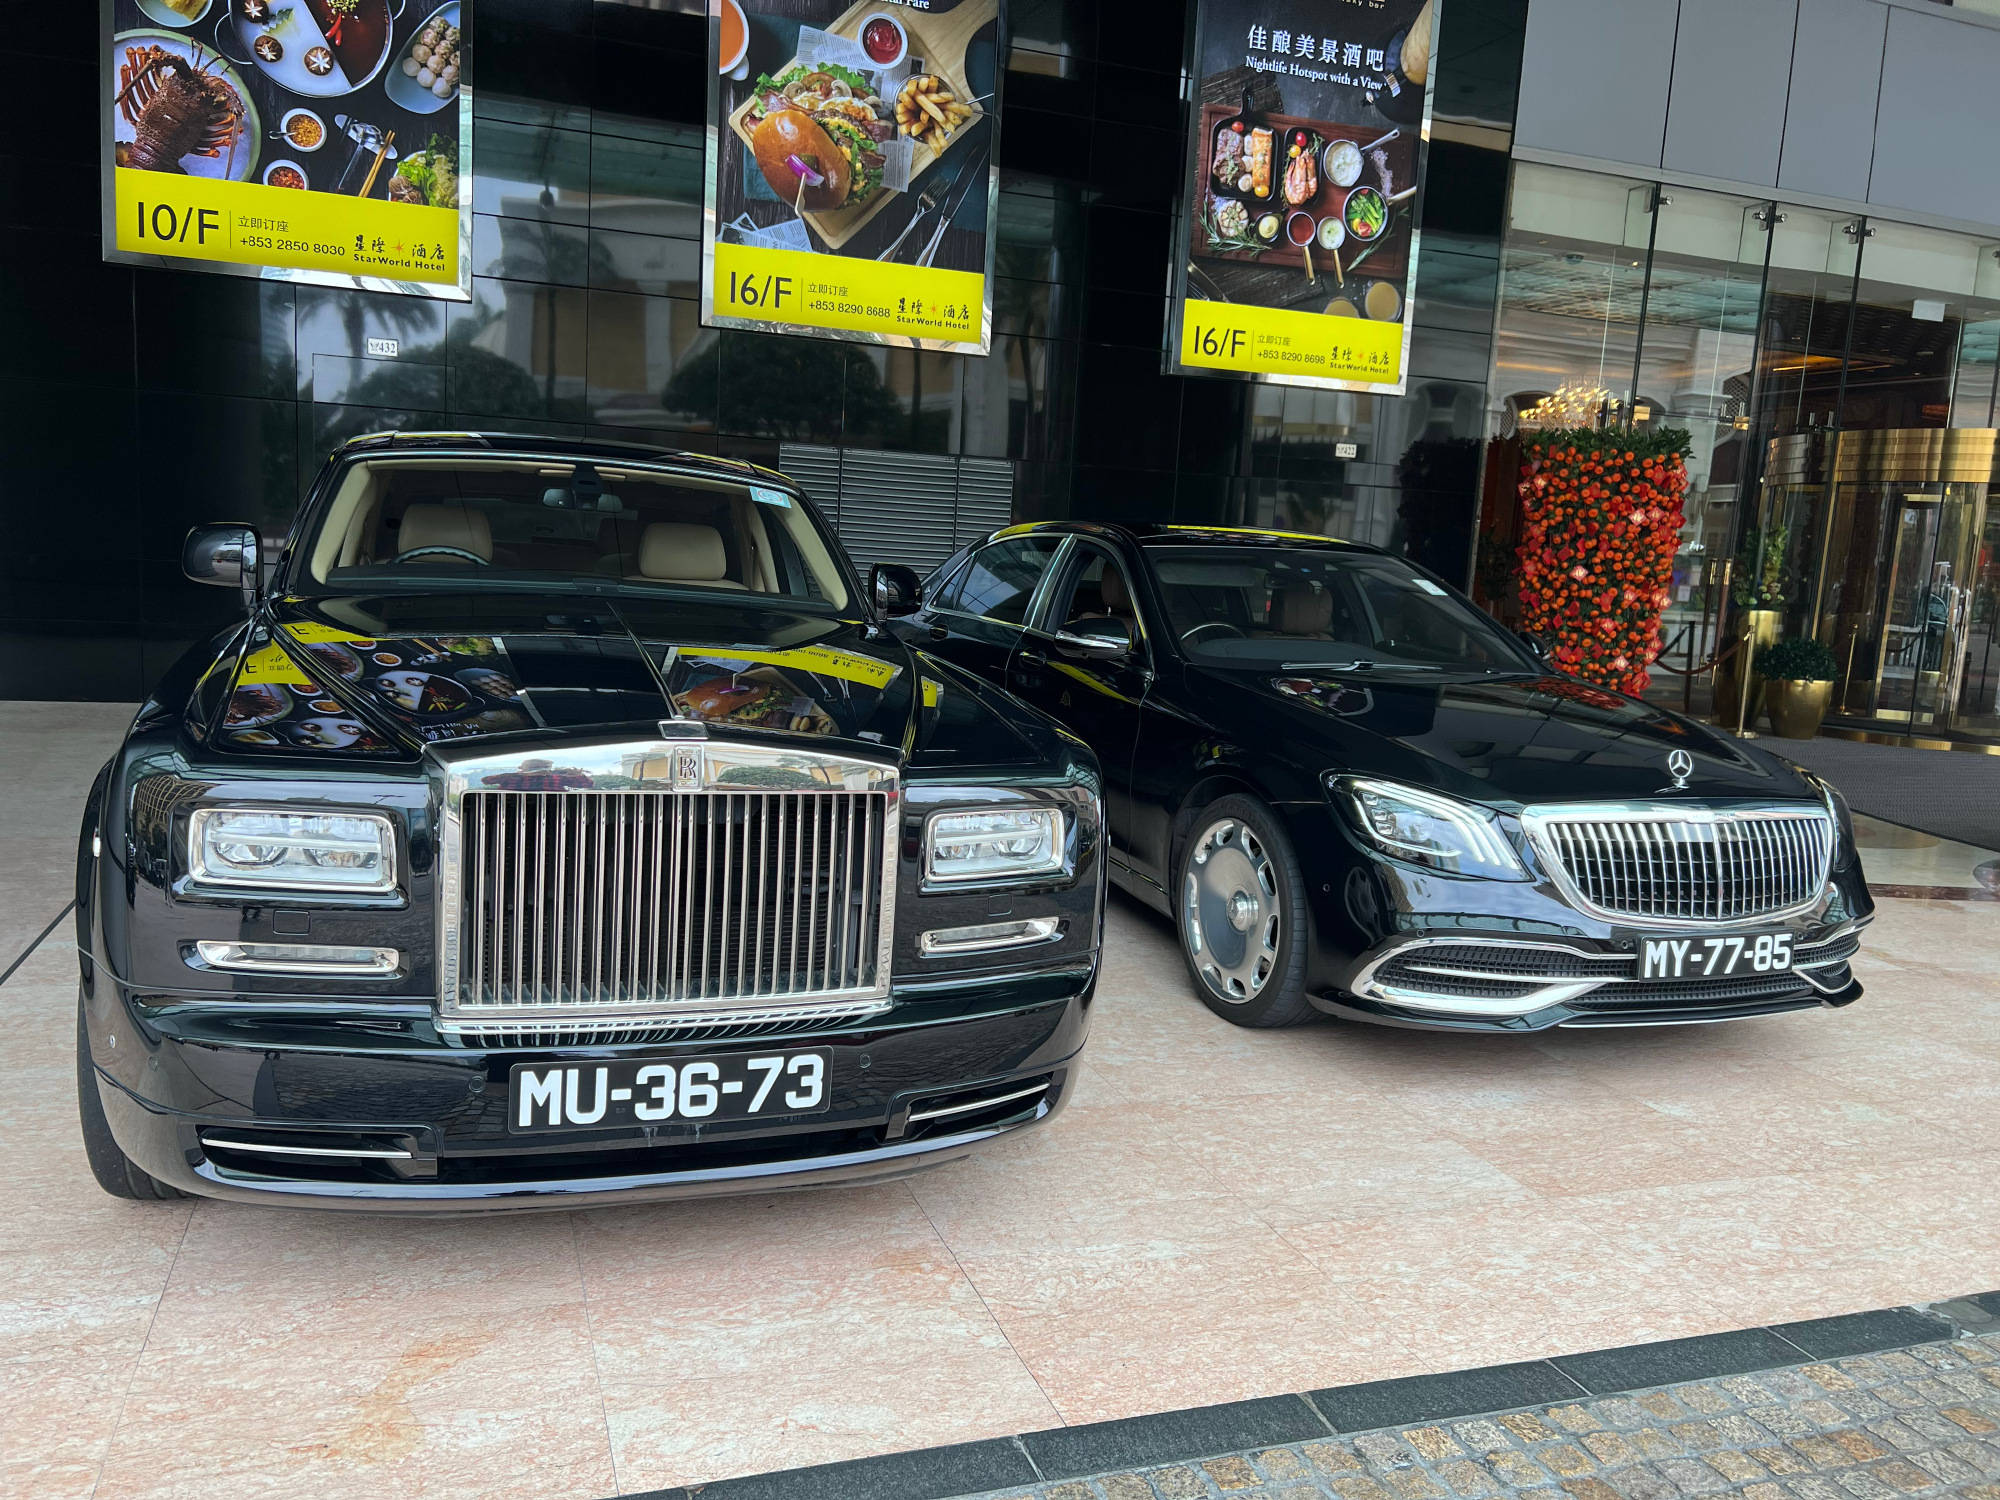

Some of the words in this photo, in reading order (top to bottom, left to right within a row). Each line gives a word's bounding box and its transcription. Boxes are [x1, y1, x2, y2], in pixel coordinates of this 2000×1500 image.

[1247, 24, 1384, 72] 佳酿美景酒吧
[1245, 55, 1288, 74] Nightlife
[1289, 63, 1328, 82] Hotspot
[1330, 72, 1351, 85] with
[1352, 78, 1359, 87] a
[1360, 75, 1383, 91] View
[138, 202, 219, 245] 10/F
[238, 216, 289, 233] 立即订座
[240, 236, 273, 249] +853
[276, 239, 309, 253] 2850
[313, 243, 346, 256] 8030
[353, 253, 411, 268] StarWorld
[415, 261, 446, 272] Hotel
[730, 272, 793, 309] 16/F
[808, 282, 849, 297] 立即订座
[808, 300, 835, 312] +853
[837, 302, 864, 315] 8290
[866, 305, 891, 318] 8688
[896, 315, 942, 327] StarWorld
[945, 320, 969, 330] Hotel
[1194, 325, 1246, 358] 16/F
[1257, 349, 1279, 360] +853
[1281, 352, 1303, 362] 8290
[1304, 353, 1326, 364] 8698
[1330, 362, 1368, 372] StarWorld
[1369, 366, 1389, 375] Hotel
[1643, 933, 1793, 979] MY-77-85
[518, 1053, 825, 1128] MU-36-73
